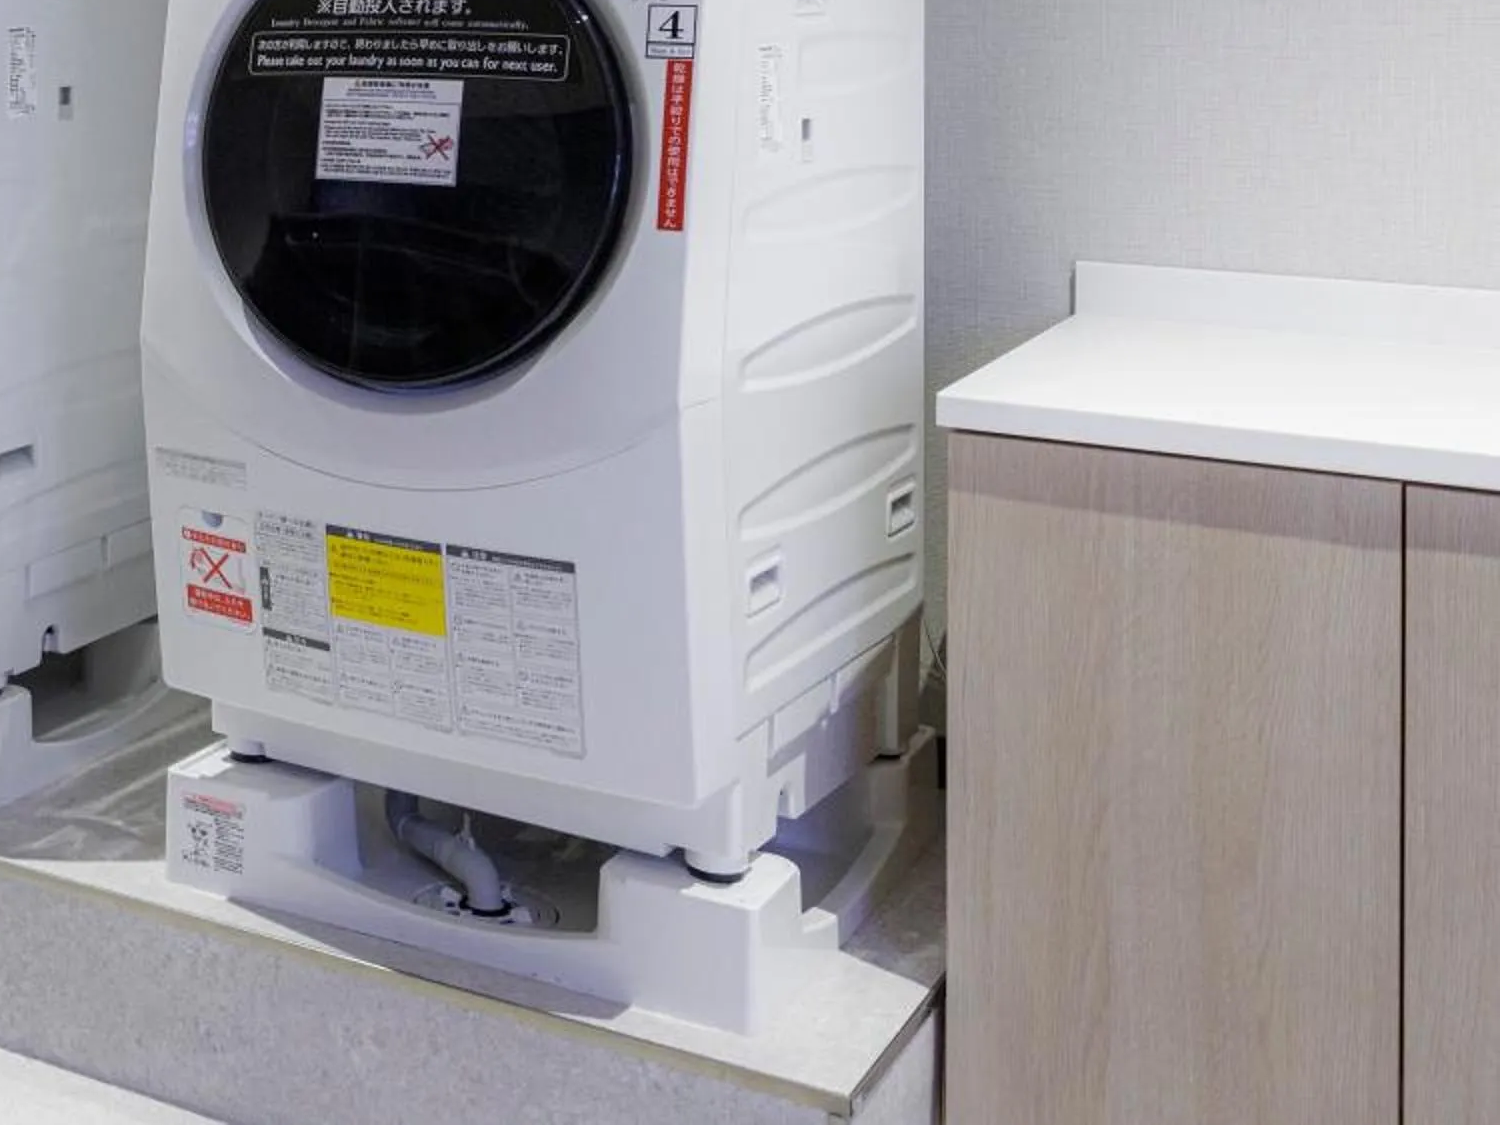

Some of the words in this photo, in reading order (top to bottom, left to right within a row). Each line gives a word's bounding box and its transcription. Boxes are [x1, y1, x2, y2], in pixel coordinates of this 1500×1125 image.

[658, 10, 685, 39] 4
[257, 54, 284, 66] Please
[285, 54, 305, 66] take
[307, 56, 323, 66] out
[326, 56, 346, 69] your
[349, 53, 384, 69] laundry
[400, 57, 424, 66] soon
[440, 58, 459, 71] you
[461, 59, 480, 69] can
[483, 56, 500, 69] for
[502, 60, 528, 71] next
[531, 61, 558, 73] user.
